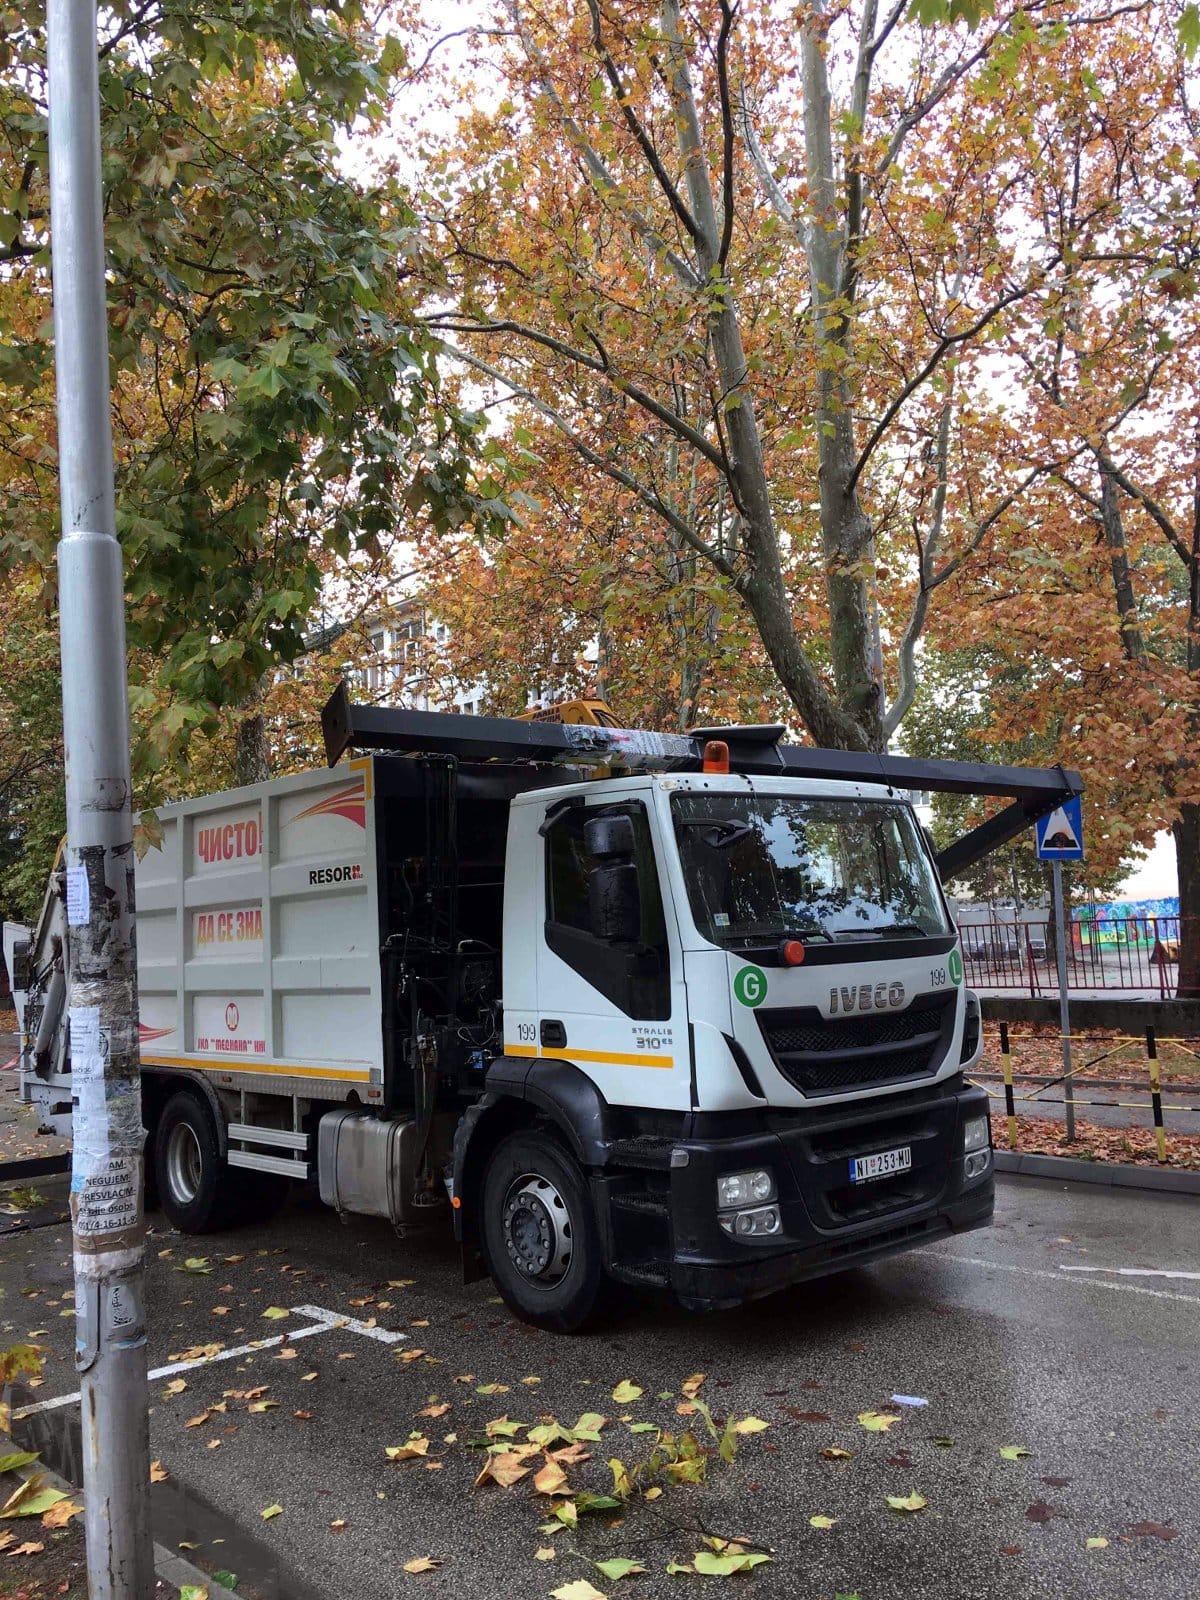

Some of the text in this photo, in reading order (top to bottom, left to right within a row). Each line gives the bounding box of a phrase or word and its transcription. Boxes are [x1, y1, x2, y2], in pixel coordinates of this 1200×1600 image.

[309, 866, 352, 885] RESOR
[743, 973, 760, 1000] G
[930, 968, 946, 987] 199
[829, 981, 905, 1014] IVECO
[517, 1023, 536, 1041] 199
[632, 1027, 673, 1035] STRALIS
[636, 1037, 661, 1049] 310
[856, 1159, 868, 1178] NI
[877, 1148, 910, 1172] 253-MU
